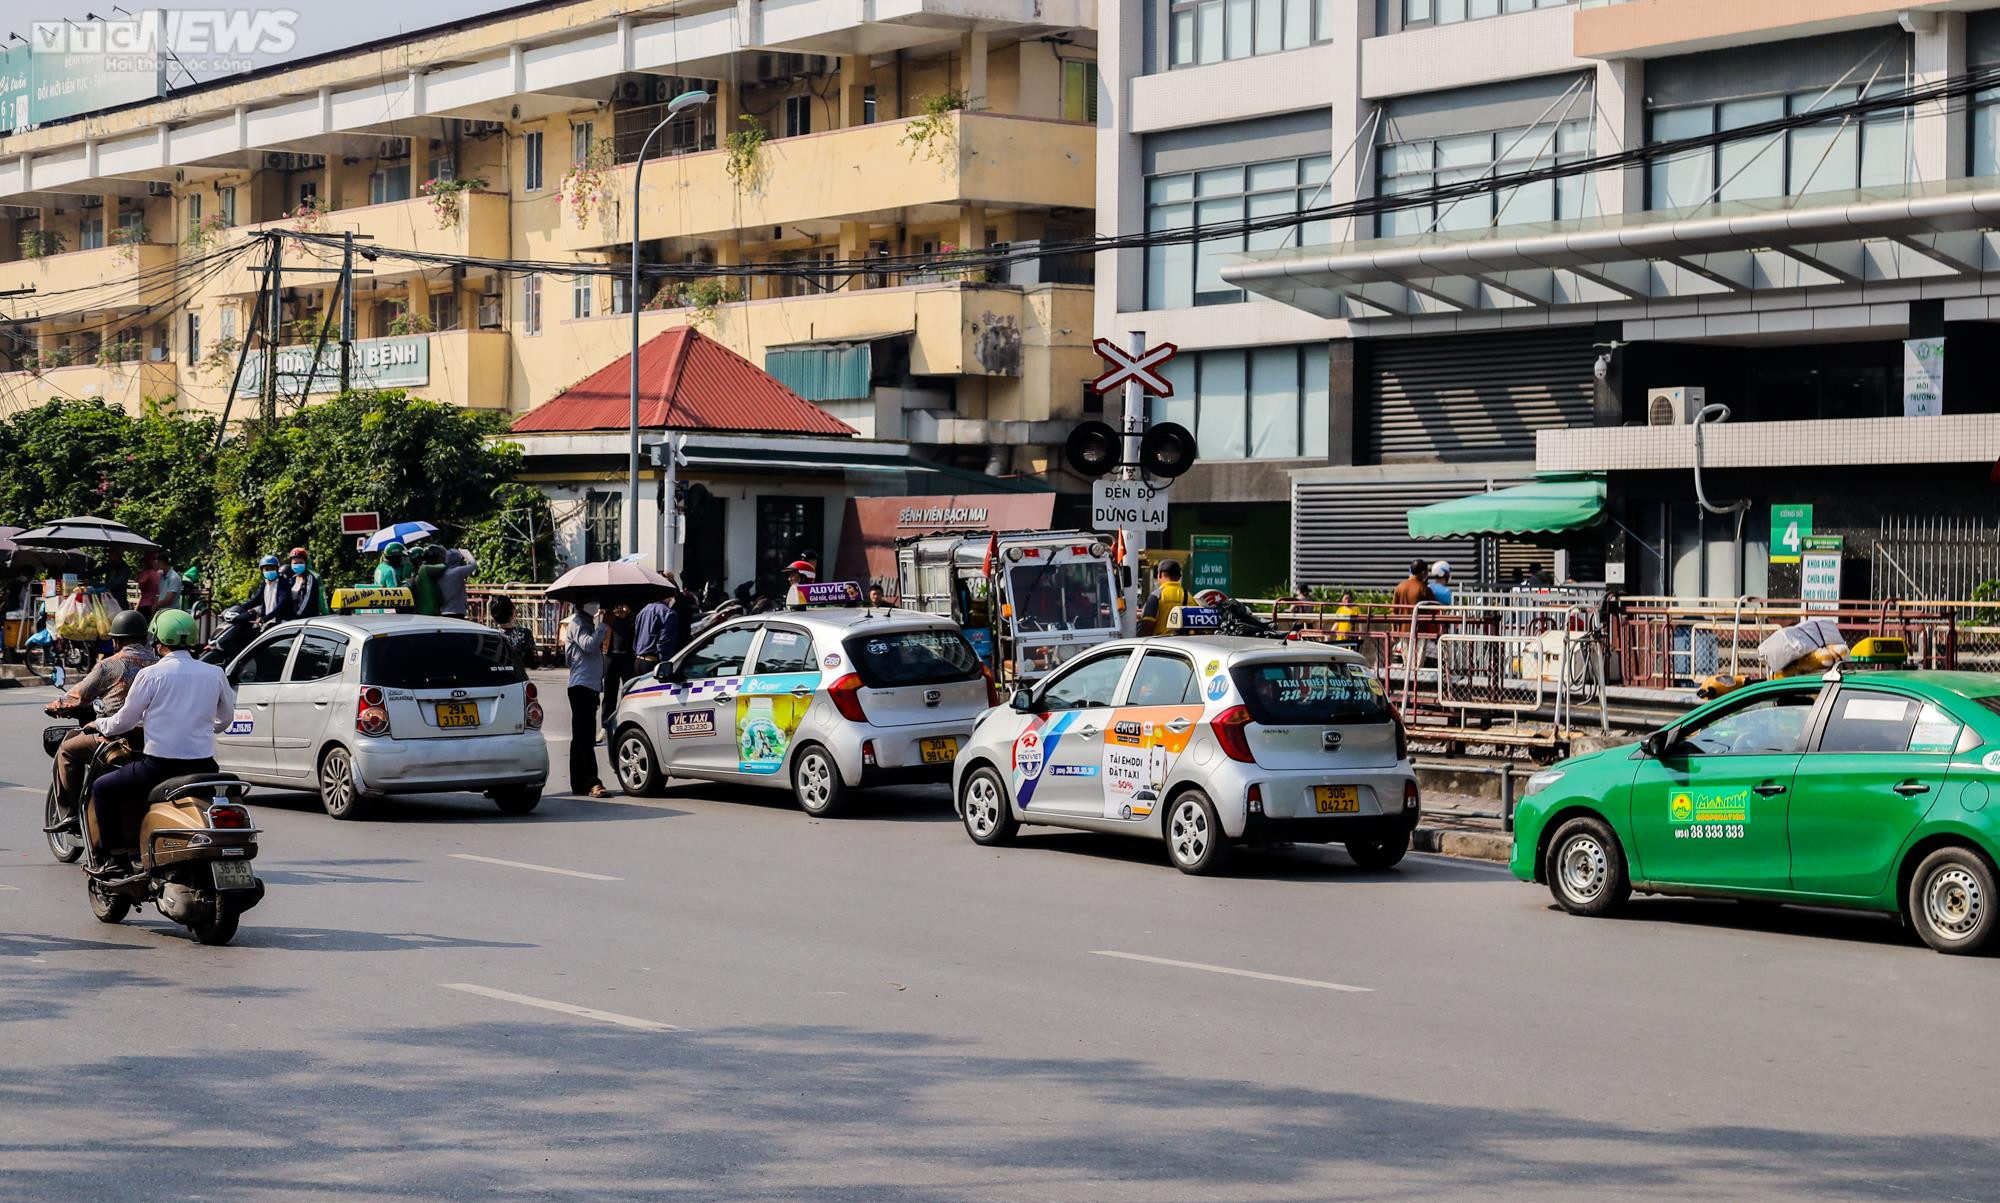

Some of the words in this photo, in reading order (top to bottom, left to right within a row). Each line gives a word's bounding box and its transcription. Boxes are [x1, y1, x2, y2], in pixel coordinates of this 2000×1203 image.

[368, 343, 418, 370] BỆNH
[1105, 484, 1130, 499] ĐÈN
[900, 507, 922, 525] BỆNH
[923, 506, 944, 524] VIỆN
[944, 508, 968, 525] BẠCH
[969, 507, 988, 522] MAI
[1096, 505, 1137, 522] DỪNG
[1142, 510, 1164, 525] LẠI
[1782, 521, 1800, 552] 4
[378, 589, 403, 597] TAXI
[1187, 615, 1218, 625] TAXI
[1277, 680, 1299, 688] TAXI
[448, 704, 467, 715] 29A
[689, 713, 708, 723] TAXI
[929, 741, 947, 750] 30A
[926, 750, 954, 761] 981.47
[1124, 769, 1140, 779] TAXI
[1118, 780, 1134, 790] 50%
[1327, 787, 1346, 799] 30G
[1690, 825, 1704, 838] 38
[1705, 825, 1723, 838] 333
[1725, 825, 1744, 838] 333
